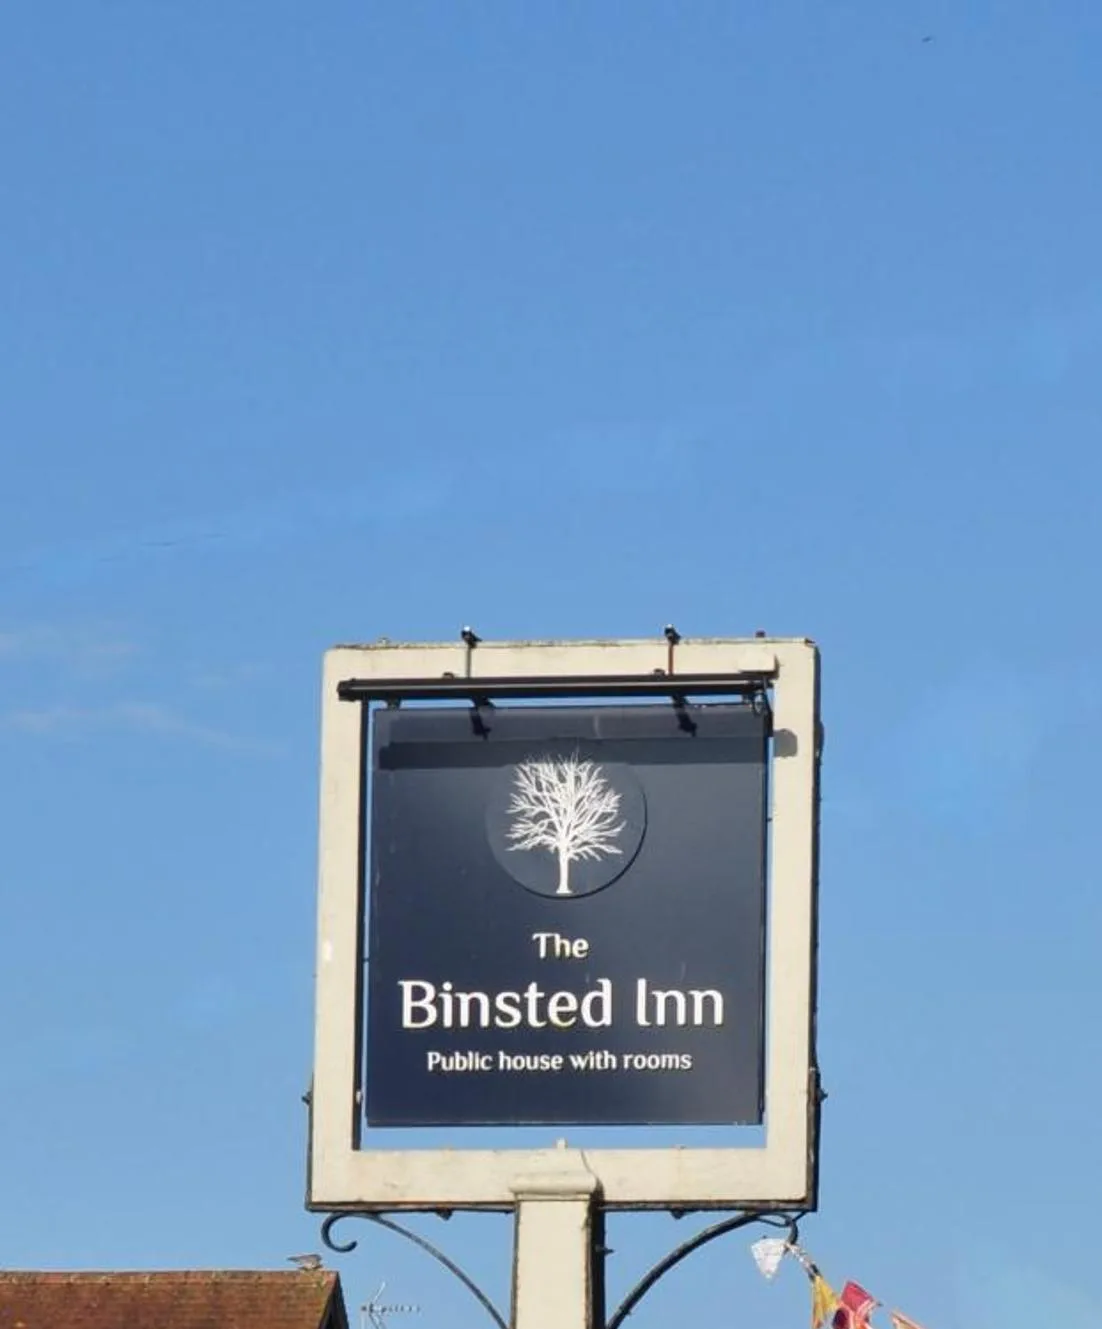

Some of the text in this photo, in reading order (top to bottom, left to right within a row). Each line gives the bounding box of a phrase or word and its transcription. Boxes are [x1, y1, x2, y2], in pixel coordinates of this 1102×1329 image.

[532, 932, 589, 959] The
[398, 978, 724, 1028] Binsted Inn
[427, 1049, 692, 1071] Public house with rooms
